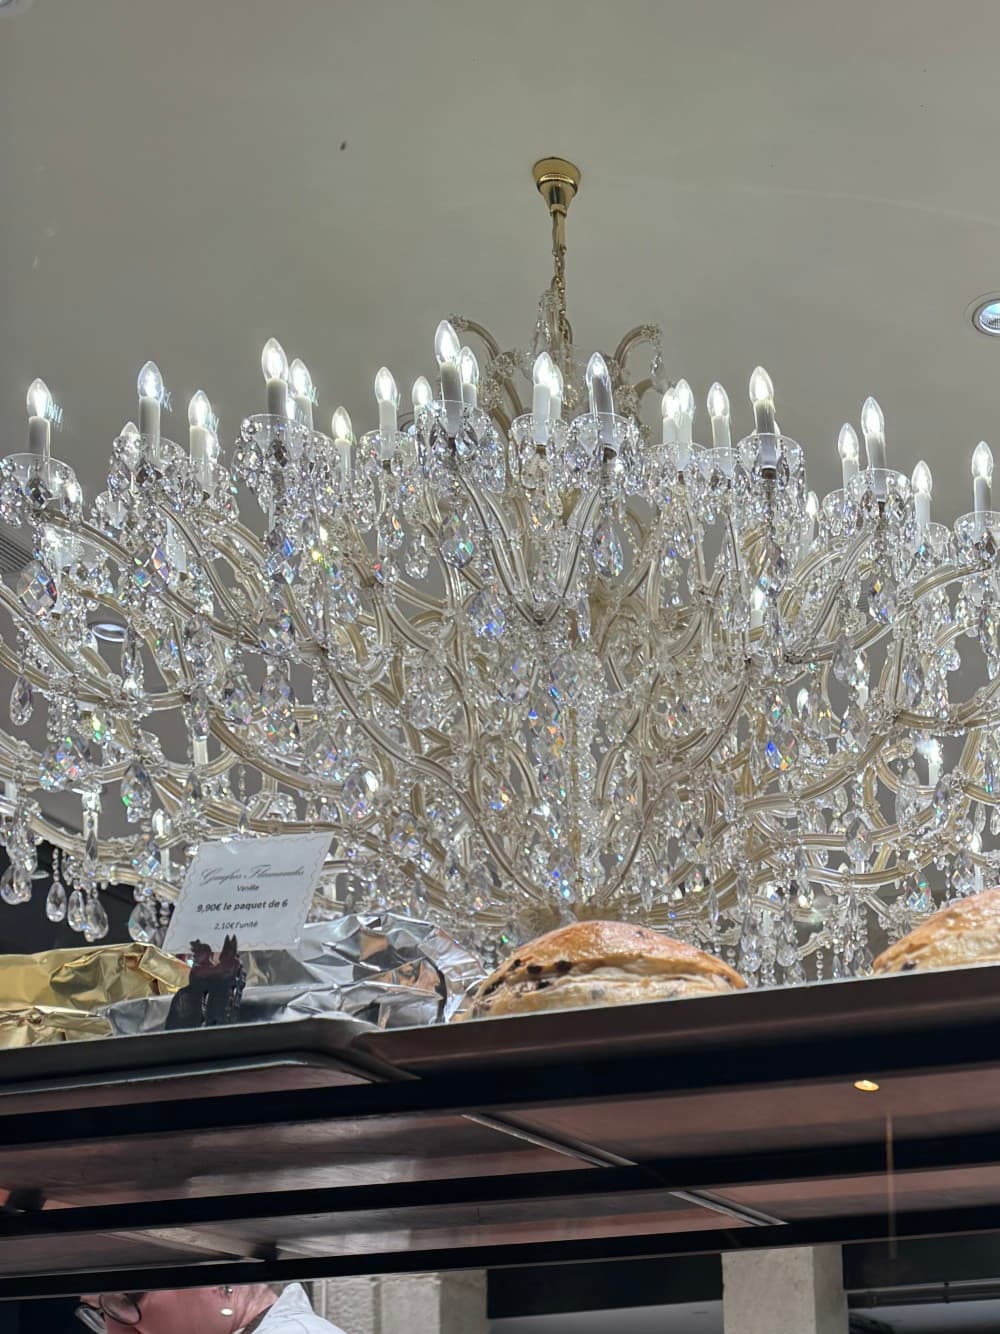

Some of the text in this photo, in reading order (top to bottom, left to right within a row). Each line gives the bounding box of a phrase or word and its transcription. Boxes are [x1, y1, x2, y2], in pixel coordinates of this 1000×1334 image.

[196, 898, 289, 913] 9,90€ le paquet de 6
